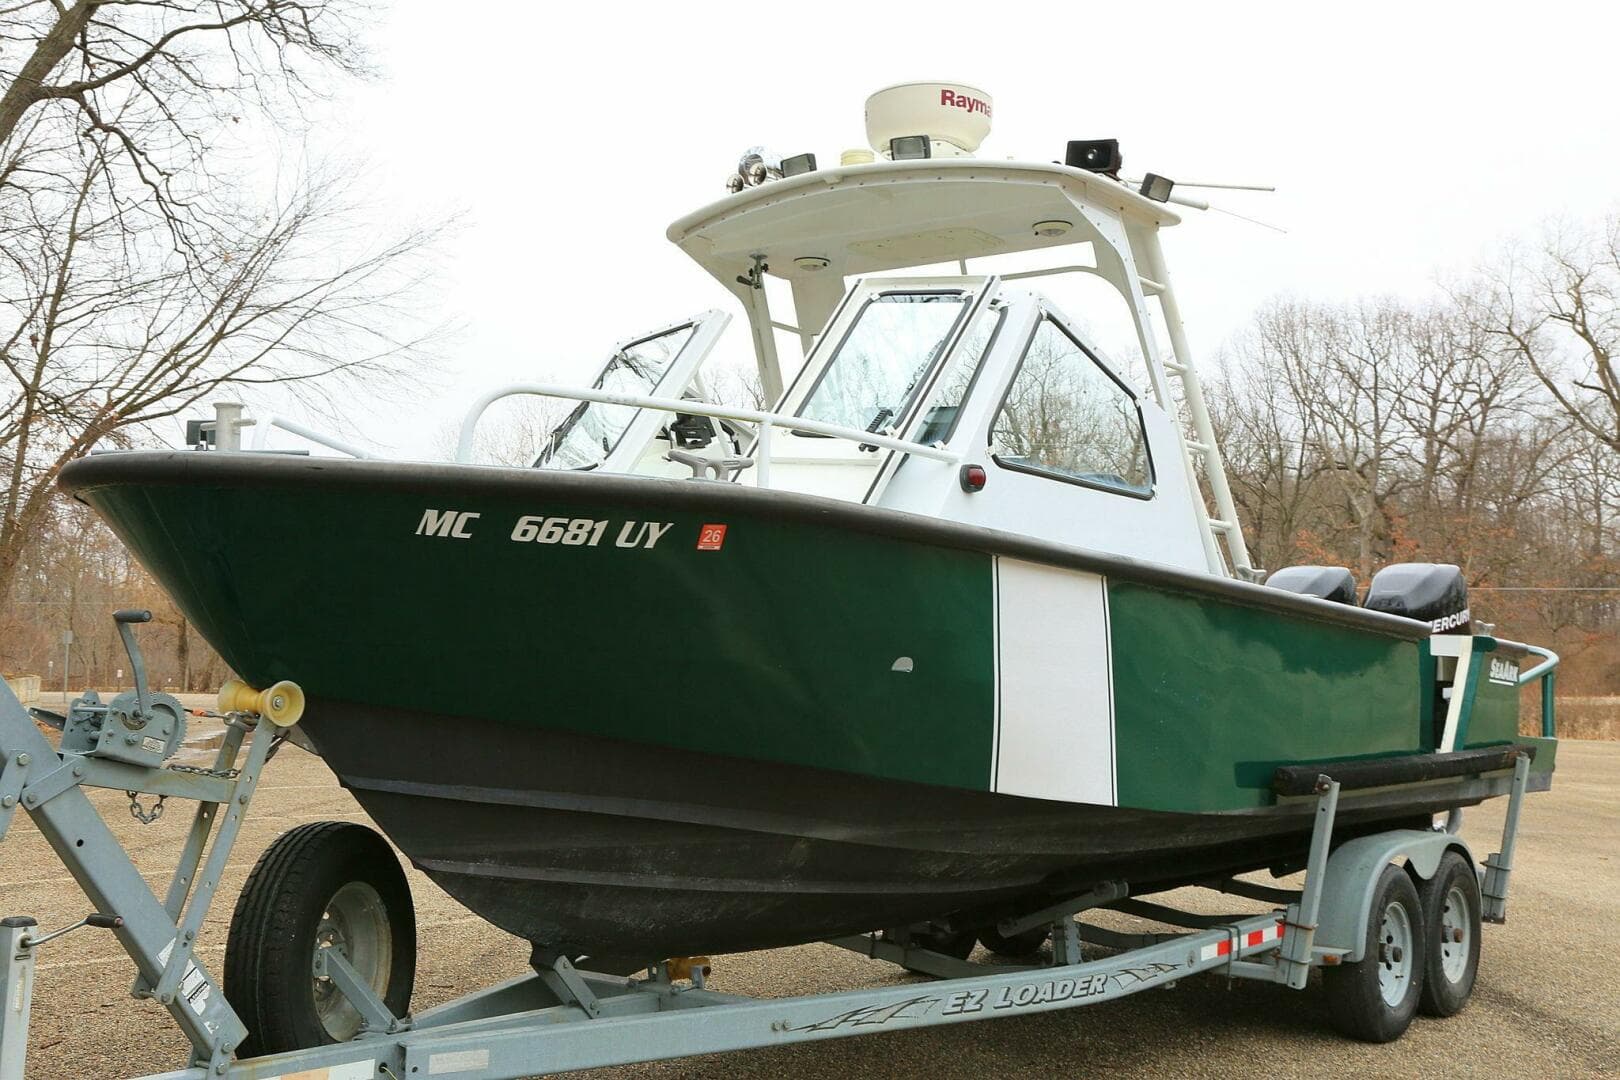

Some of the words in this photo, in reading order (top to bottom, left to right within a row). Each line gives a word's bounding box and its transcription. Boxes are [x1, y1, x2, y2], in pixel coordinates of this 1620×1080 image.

[415, 508, 481, 539] MC
[510, 515, 609, 546] 6681
[615, 520, 675, 549] UY
[702, 529, 722, 543] 26
[1429, 608, 1470, 634] ERCUR
[942, 988, 989, 1016] EZ
[993, 973, 1108, 1009] LOADER
